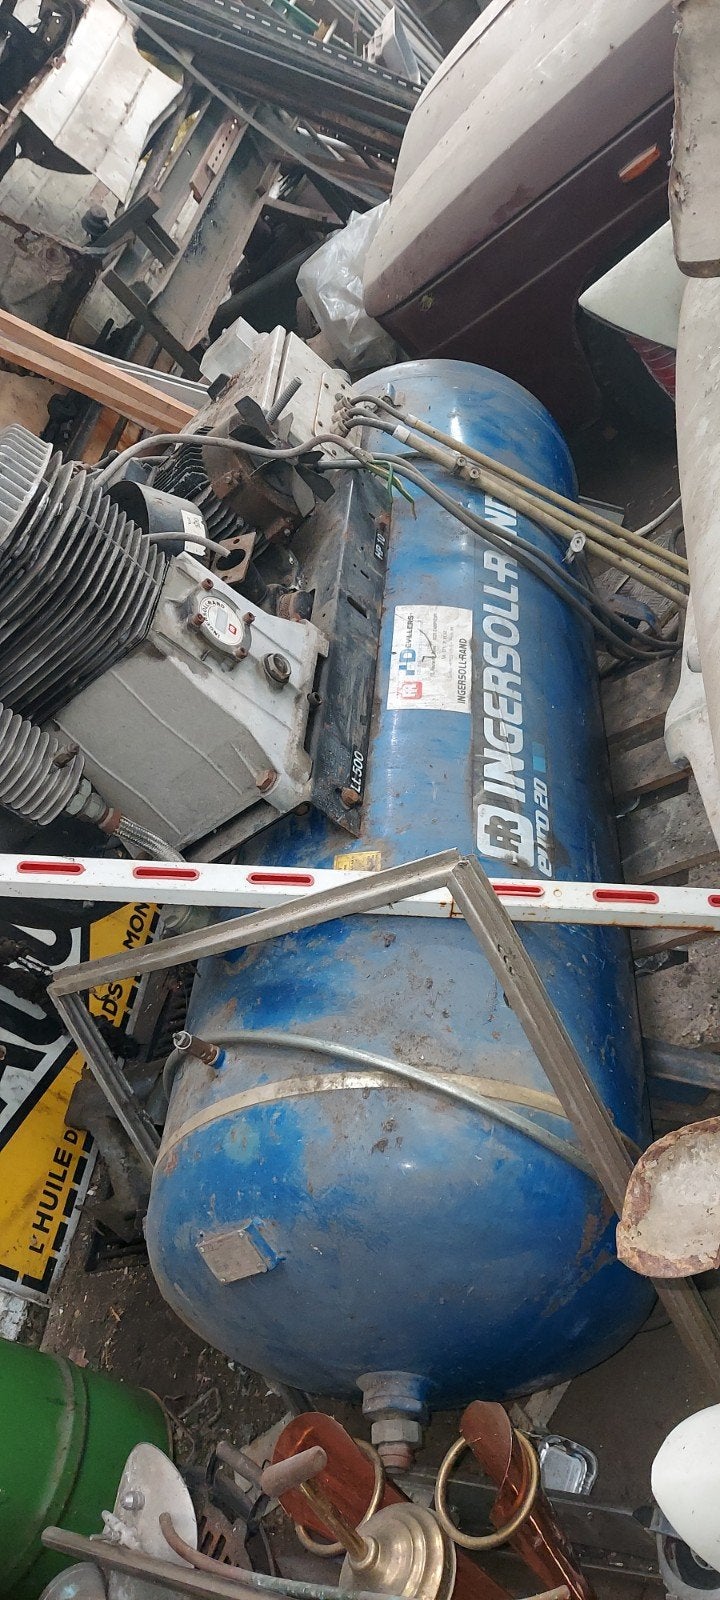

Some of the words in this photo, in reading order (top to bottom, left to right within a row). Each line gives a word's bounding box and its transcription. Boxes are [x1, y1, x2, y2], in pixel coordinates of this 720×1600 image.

[377, 533, 386, 546] 10
[457, 638, 467, 704] INGERSOLL-RAND
[483, 496, 526, 803] INGERSOLL-RN
[533, 777, 549, 811] 20
[535, 810, 552, 877] euro
